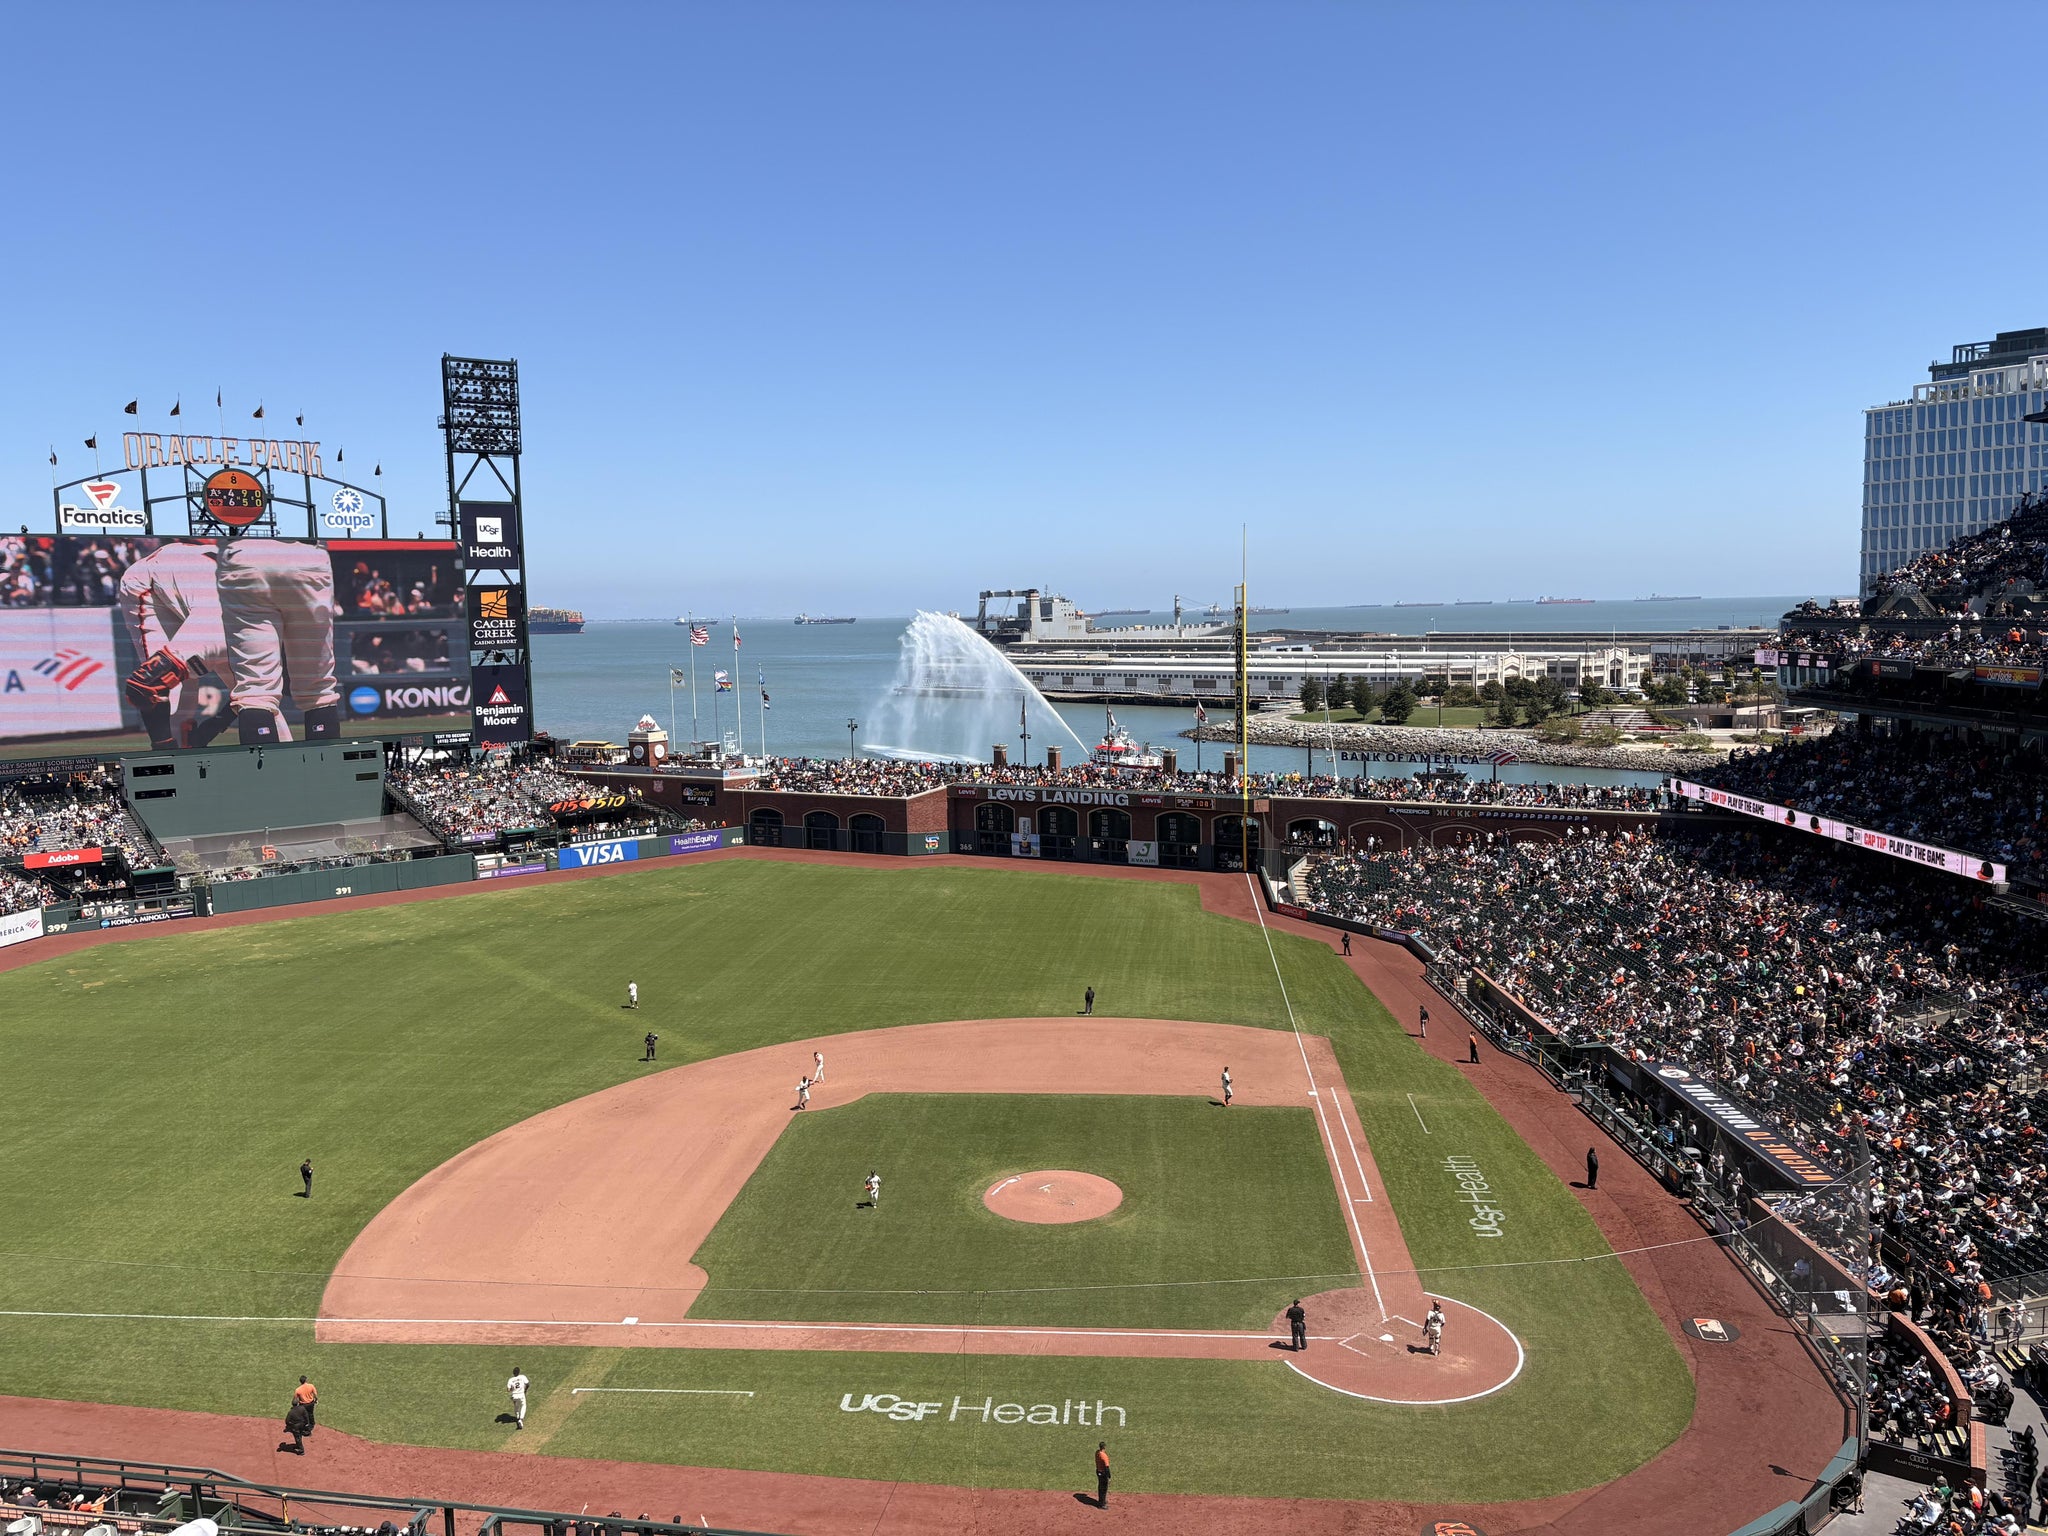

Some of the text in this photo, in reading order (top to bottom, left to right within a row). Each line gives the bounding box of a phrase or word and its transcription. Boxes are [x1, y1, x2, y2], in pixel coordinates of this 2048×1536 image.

[122, 432, 325, 478] ORACLE PARK
[231, 476, 237, 484] 8
[228, 489, 234, 497] 4
[255, 490, 261, 498] 0
[229, 498, 235, 506] 6
[63, 507, 144, 525] Fanatics
[327, 515, 371, 529] coupa
[479, 525, 500, 535] UCSF
[469, 546, 512, 558] Health
[473, 620, 516, 628] CACHE
[475, 629, 516, 638] CREEK
[476, 704, 524, 717] Benjamin
[484, 716, 517, 726] Moore
[506, 740, 528, 748] LIGHT
[1341, 752, 1480, 765] BANK OF AMERICA
[549, 795, 626, 813] 415 510
[1042, 790, 1129, 806] LANDING
[1728, 796, 1738, 808] PLAY
[1738, 799, 1744, 810] OF
[1744, 800, 1752, 812] THE
[674, 834, 718, 846] HealthEquity
[574, 844, 625, 866] VISA
[1864, 832, 1876, 846] CAP
[1876, 836, 1886, 849] TIP
[1889, 840, 1905, 855] PLAY
[1905, 844, 1913, 857] OF
[1914, 846, 1926, 860] THE
[1926, 849, 1946, 866] GAME
[48, 854, 80, 864] Adobe
[1227, 860, 1243, 868] 309
[336, 886, 352, 894] 391
[110, 913, 170, 926] KONICA MINOLTA
[48, 924, 68, 933] 399
[1679, 1084, 1834, 1182] WELCOME TO ORACLE PARK
[1440, 1156, 1506, 1237] UCSF Health
[840, 1394, 1127, 1427] UCSF Health
